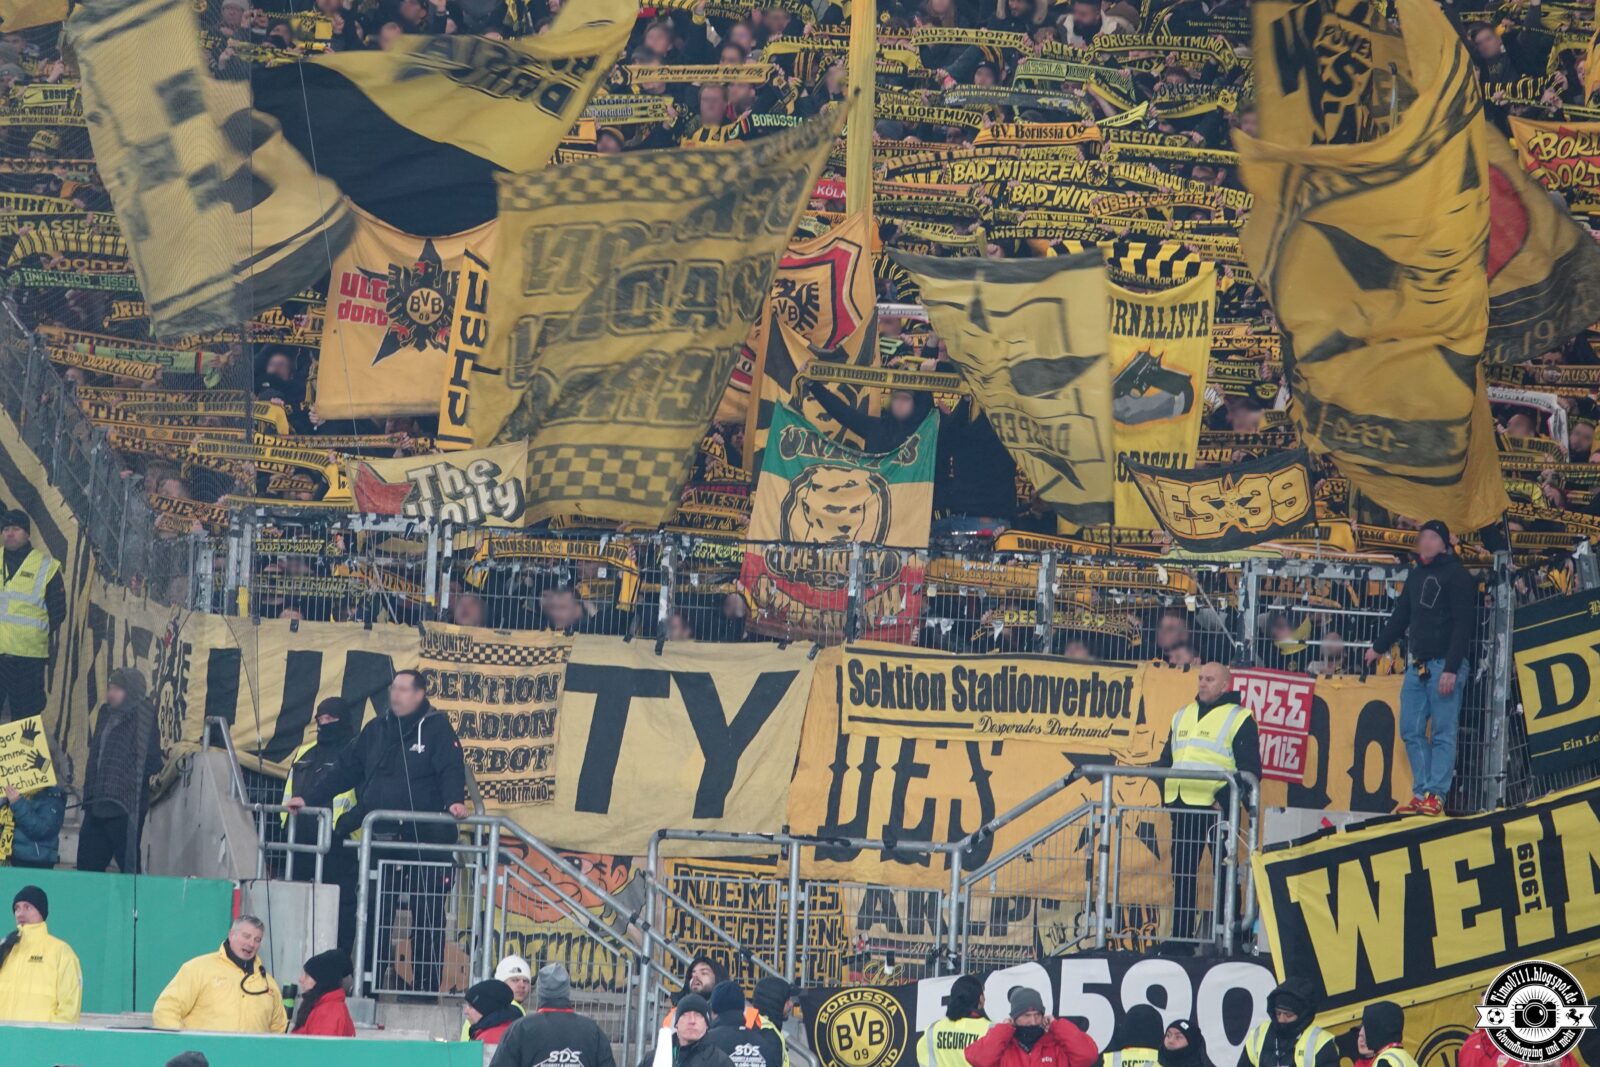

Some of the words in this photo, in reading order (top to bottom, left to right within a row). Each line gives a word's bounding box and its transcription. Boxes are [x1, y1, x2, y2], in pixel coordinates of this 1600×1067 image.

[1093, 34, 1152, 48] BORUSSIA
[908, 106, 982, 126] DORTMUND
[1015, 124, 1064, 139] Borussia
[953, 160, 989, 183] BAD
[994, 158, 1089, 182] WIMPFEN
[1012, 184, 1048, 203] BAD
[410, 290, 443, 313] BVB
[405, 458, 503, 505] The
[848, 658, 946, 711] Sektion
[952, 664, 1134, 719] Stadionverbot
[1232, 676, 1310, 729] FREE
[449, 708, 558, 741] ADION
[1046, 716, 1113, 739] Dortmund
[1562, 737, 1583, 752] Ein
[0, 761, 29, 778] Deine
[499, 782, 549, 804] DORTMUND
[819, 990, 898, 1025] BORUSSIA
[836, 1010, 886, 1052] BVB
[936, 1030, 980, 1051] SECURITY
[547, 1050, 582, 1063] SDS
[735, 1044, 761, 1056] SDS
[853, 1048, 871, 1062] 09
